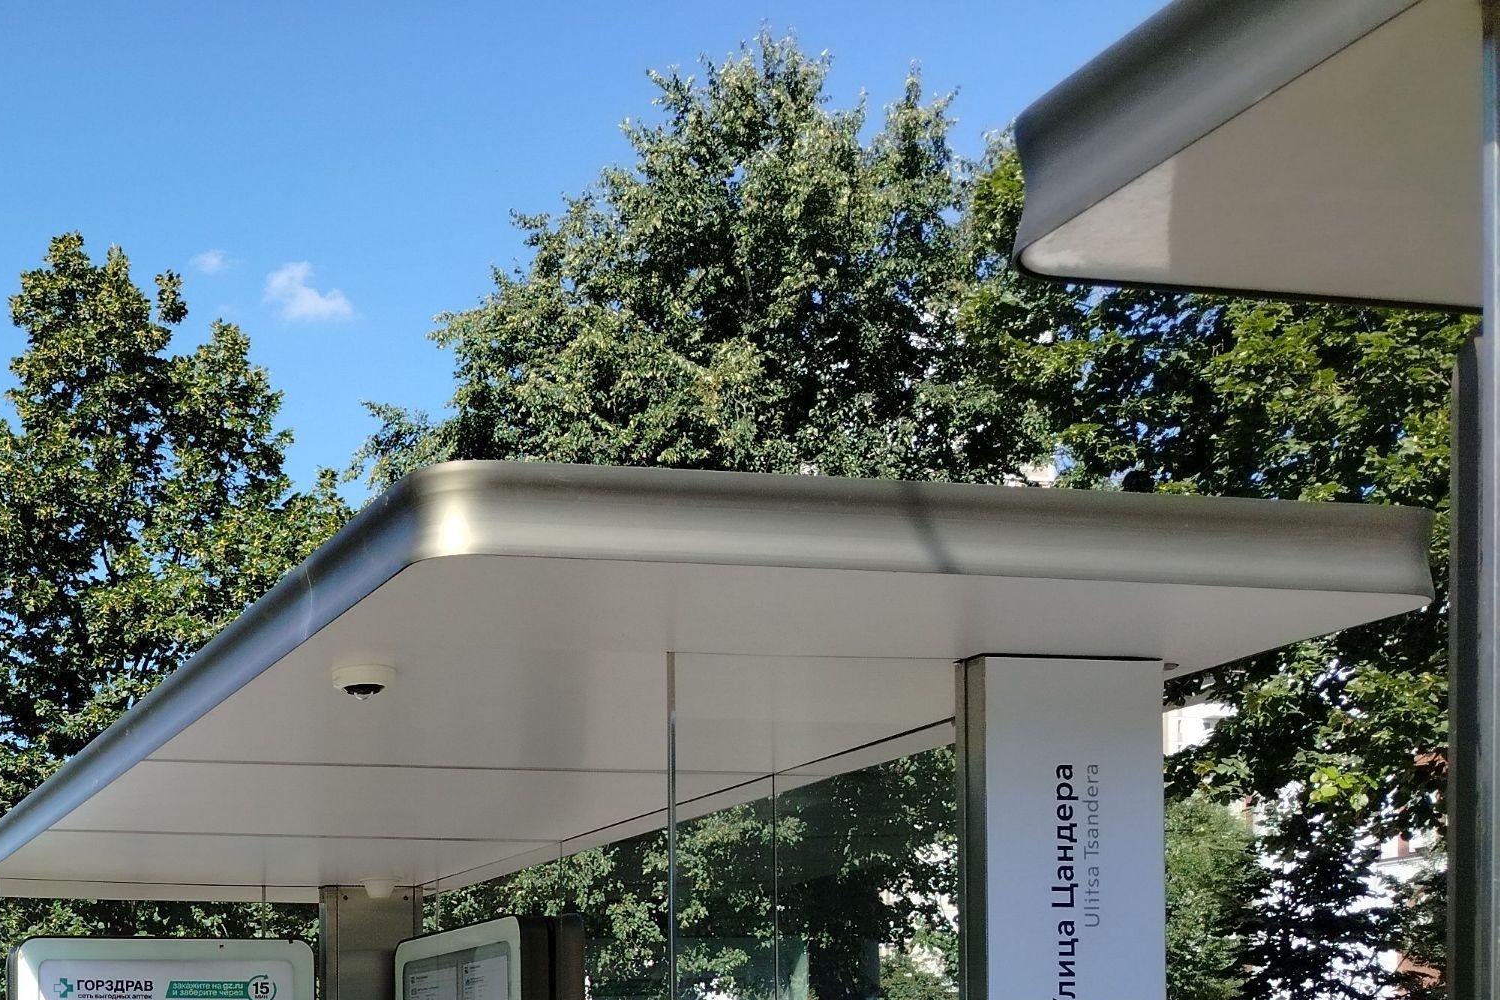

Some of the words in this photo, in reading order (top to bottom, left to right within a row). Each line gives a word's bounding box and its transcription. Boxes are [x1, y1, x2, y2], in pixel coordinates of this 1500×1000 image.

[1082, 764, 1100, 860] Tsandera
[1051, 764, 1079, 908] Цандера
[1083, 866, 1100, 928] Ulitsa
[76, 979, 154, 993] ГОРЗДРАВ
[180, 989, 218, 997] заберите
[223, 983, 244, 991] gz.ru
[252, 982, 270, 995] 15
